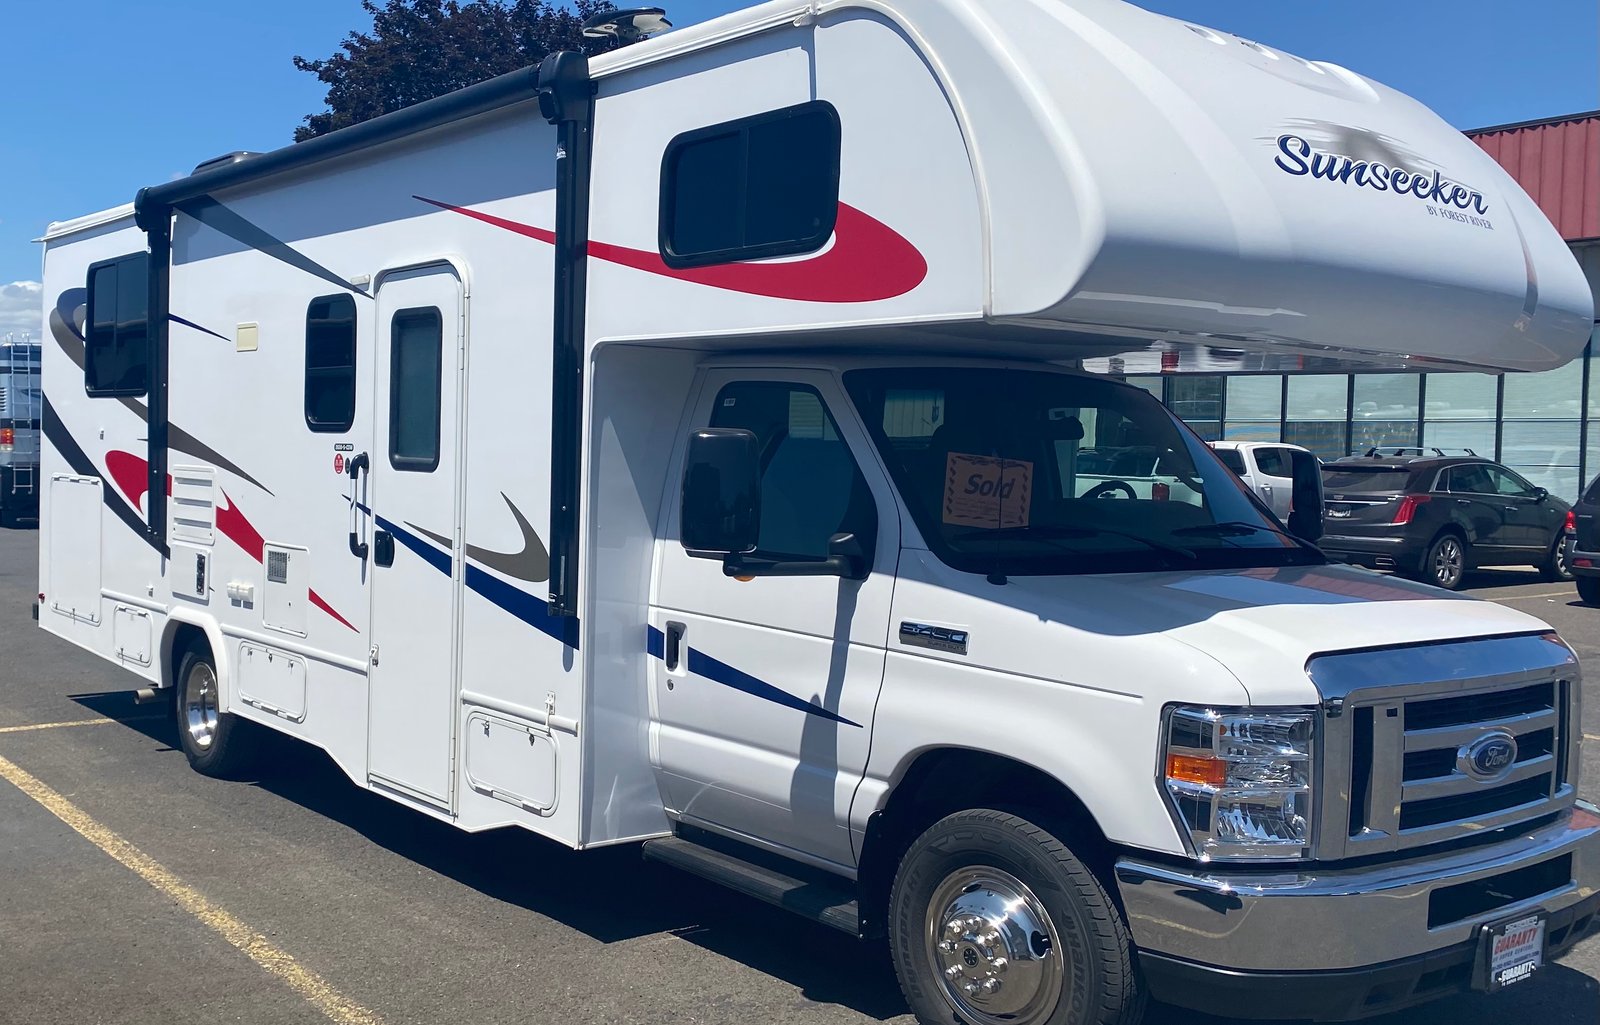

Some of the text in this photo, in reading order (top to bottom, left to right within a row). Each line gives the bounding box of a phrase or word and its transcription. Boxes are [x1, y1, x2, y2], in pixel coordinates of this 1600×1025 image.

[1274, 134, 1489, 215] Sunseeker
[1426, 205, 1494, 230] BY FOREST RIVER
[963, 473, 1017, 499] Sold
[1485, 746, 1510, 767] Ford
[1494, 927, 1538, 956] GUARANTY
